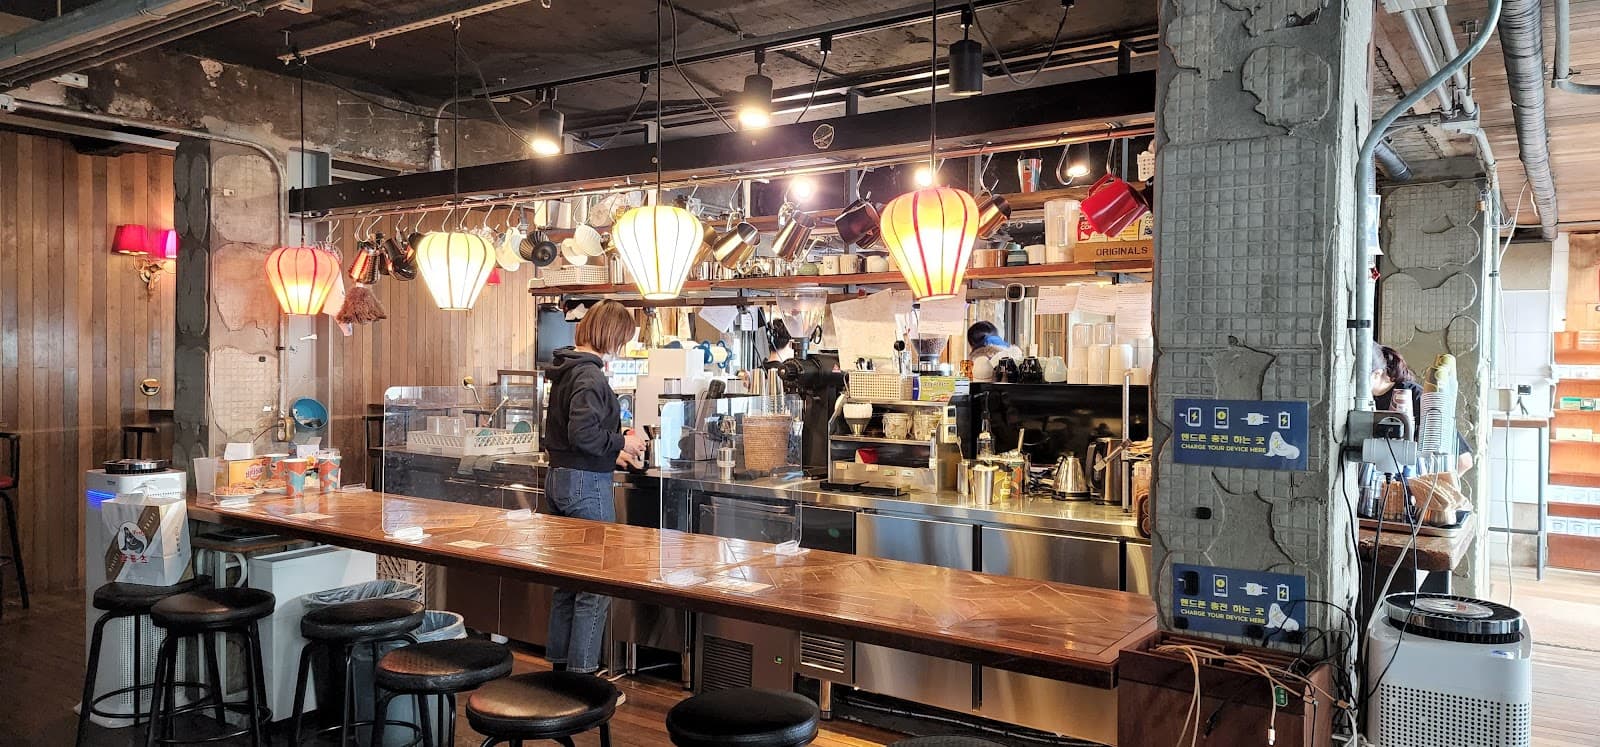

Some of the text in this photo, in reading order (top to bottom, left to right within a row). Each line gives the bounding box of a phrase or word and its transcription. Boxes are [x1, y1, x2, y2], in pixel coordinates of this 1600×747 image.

[1096, 247, 1148, 256] ORIGINALS
[1181, 433, 1264, 445] 핸드폰 충전 하는 곳
[1181, 599, 1264, 616] 핸드폰 충전 하는 곳
[1181, 609, 1206, 617] CHARGE
[1226, 614, 1248, 622] DEVICE
[1250, 617, 1265, 625] HERE
